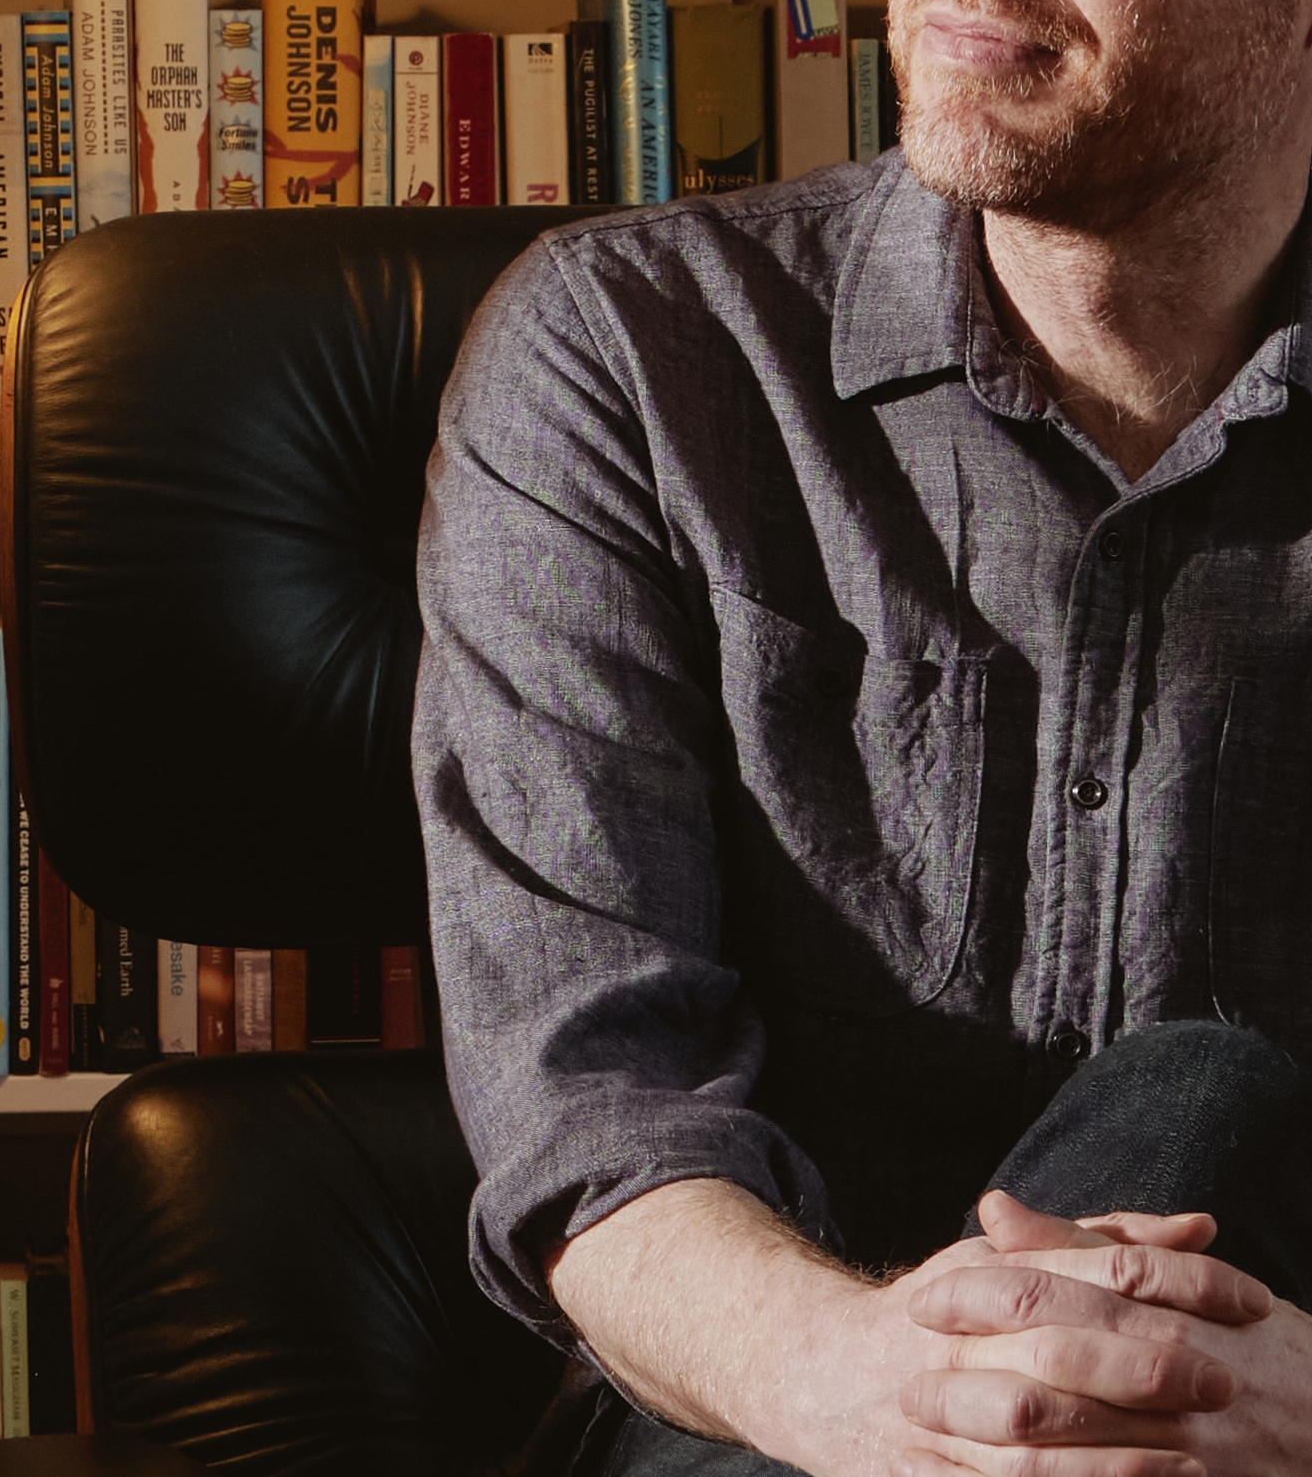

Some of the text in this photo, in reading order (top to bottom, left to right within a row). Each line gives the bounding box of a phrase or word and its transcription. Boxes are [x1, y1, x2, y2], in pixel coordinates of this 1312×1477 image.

[81, 11, 97, 155] ADAM JOHNSON
[111, 10, 127, 155] PARASITES LIKE US
[150, 66, 199, 85] ORPHAN
[164, 44, 186, 62] THE
[286, 5, 312, 133] JOHNSON
[314, 5, 338, 133] DENIS
[40, 55, 56, 169] Adam Johnson
[145, 89, 203, 108] MASTER'S
[164, 113, 188, 131] SON
[405, 81, 417, 155] JOHNSON
[418, 93, 430, 144] DIANE
